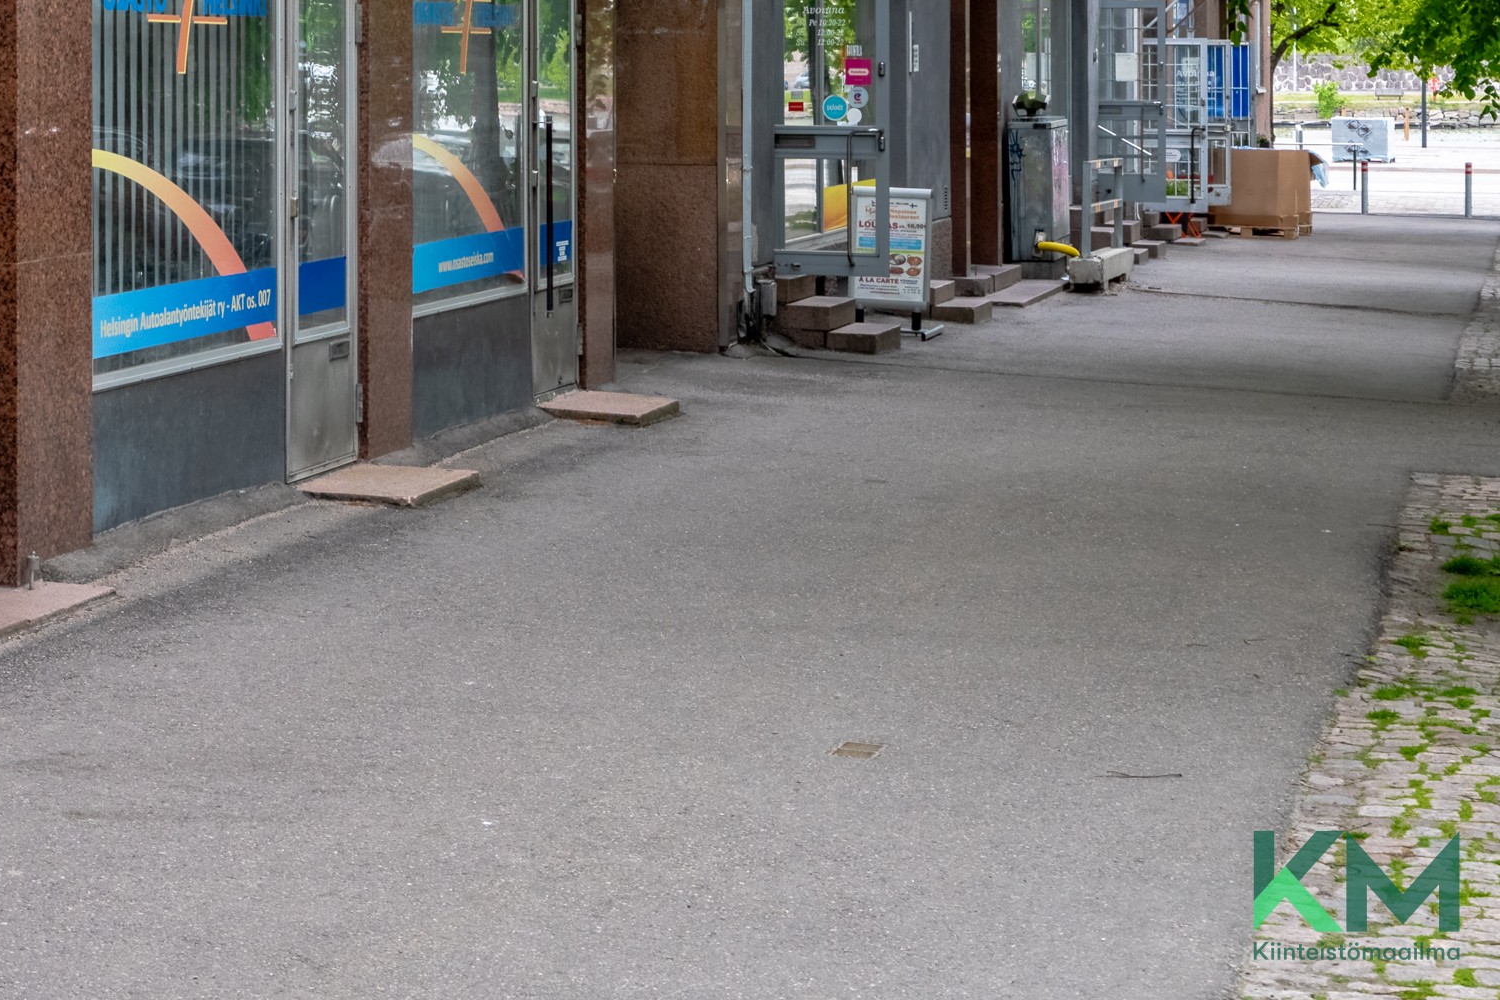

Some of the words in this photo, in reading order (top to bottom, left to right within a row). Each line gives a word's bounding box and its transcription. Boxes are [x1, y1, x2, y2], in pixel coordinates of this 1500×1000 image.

[413, 1, 454, 26] OSASTO
[802, 6, 845, 15] Avoinna
[438, 251, 495, 273] www.osastoseiska.com
[100, 313, 139, 338] Helsingin
[140, 299, 217, 331] Autoalantyöntekijät
[217, 301, 225, 319] ry
[231, 293, 246, 312] AKT
[246, 296, 257, 309] os.
[258, 289, 271, 307] 007
